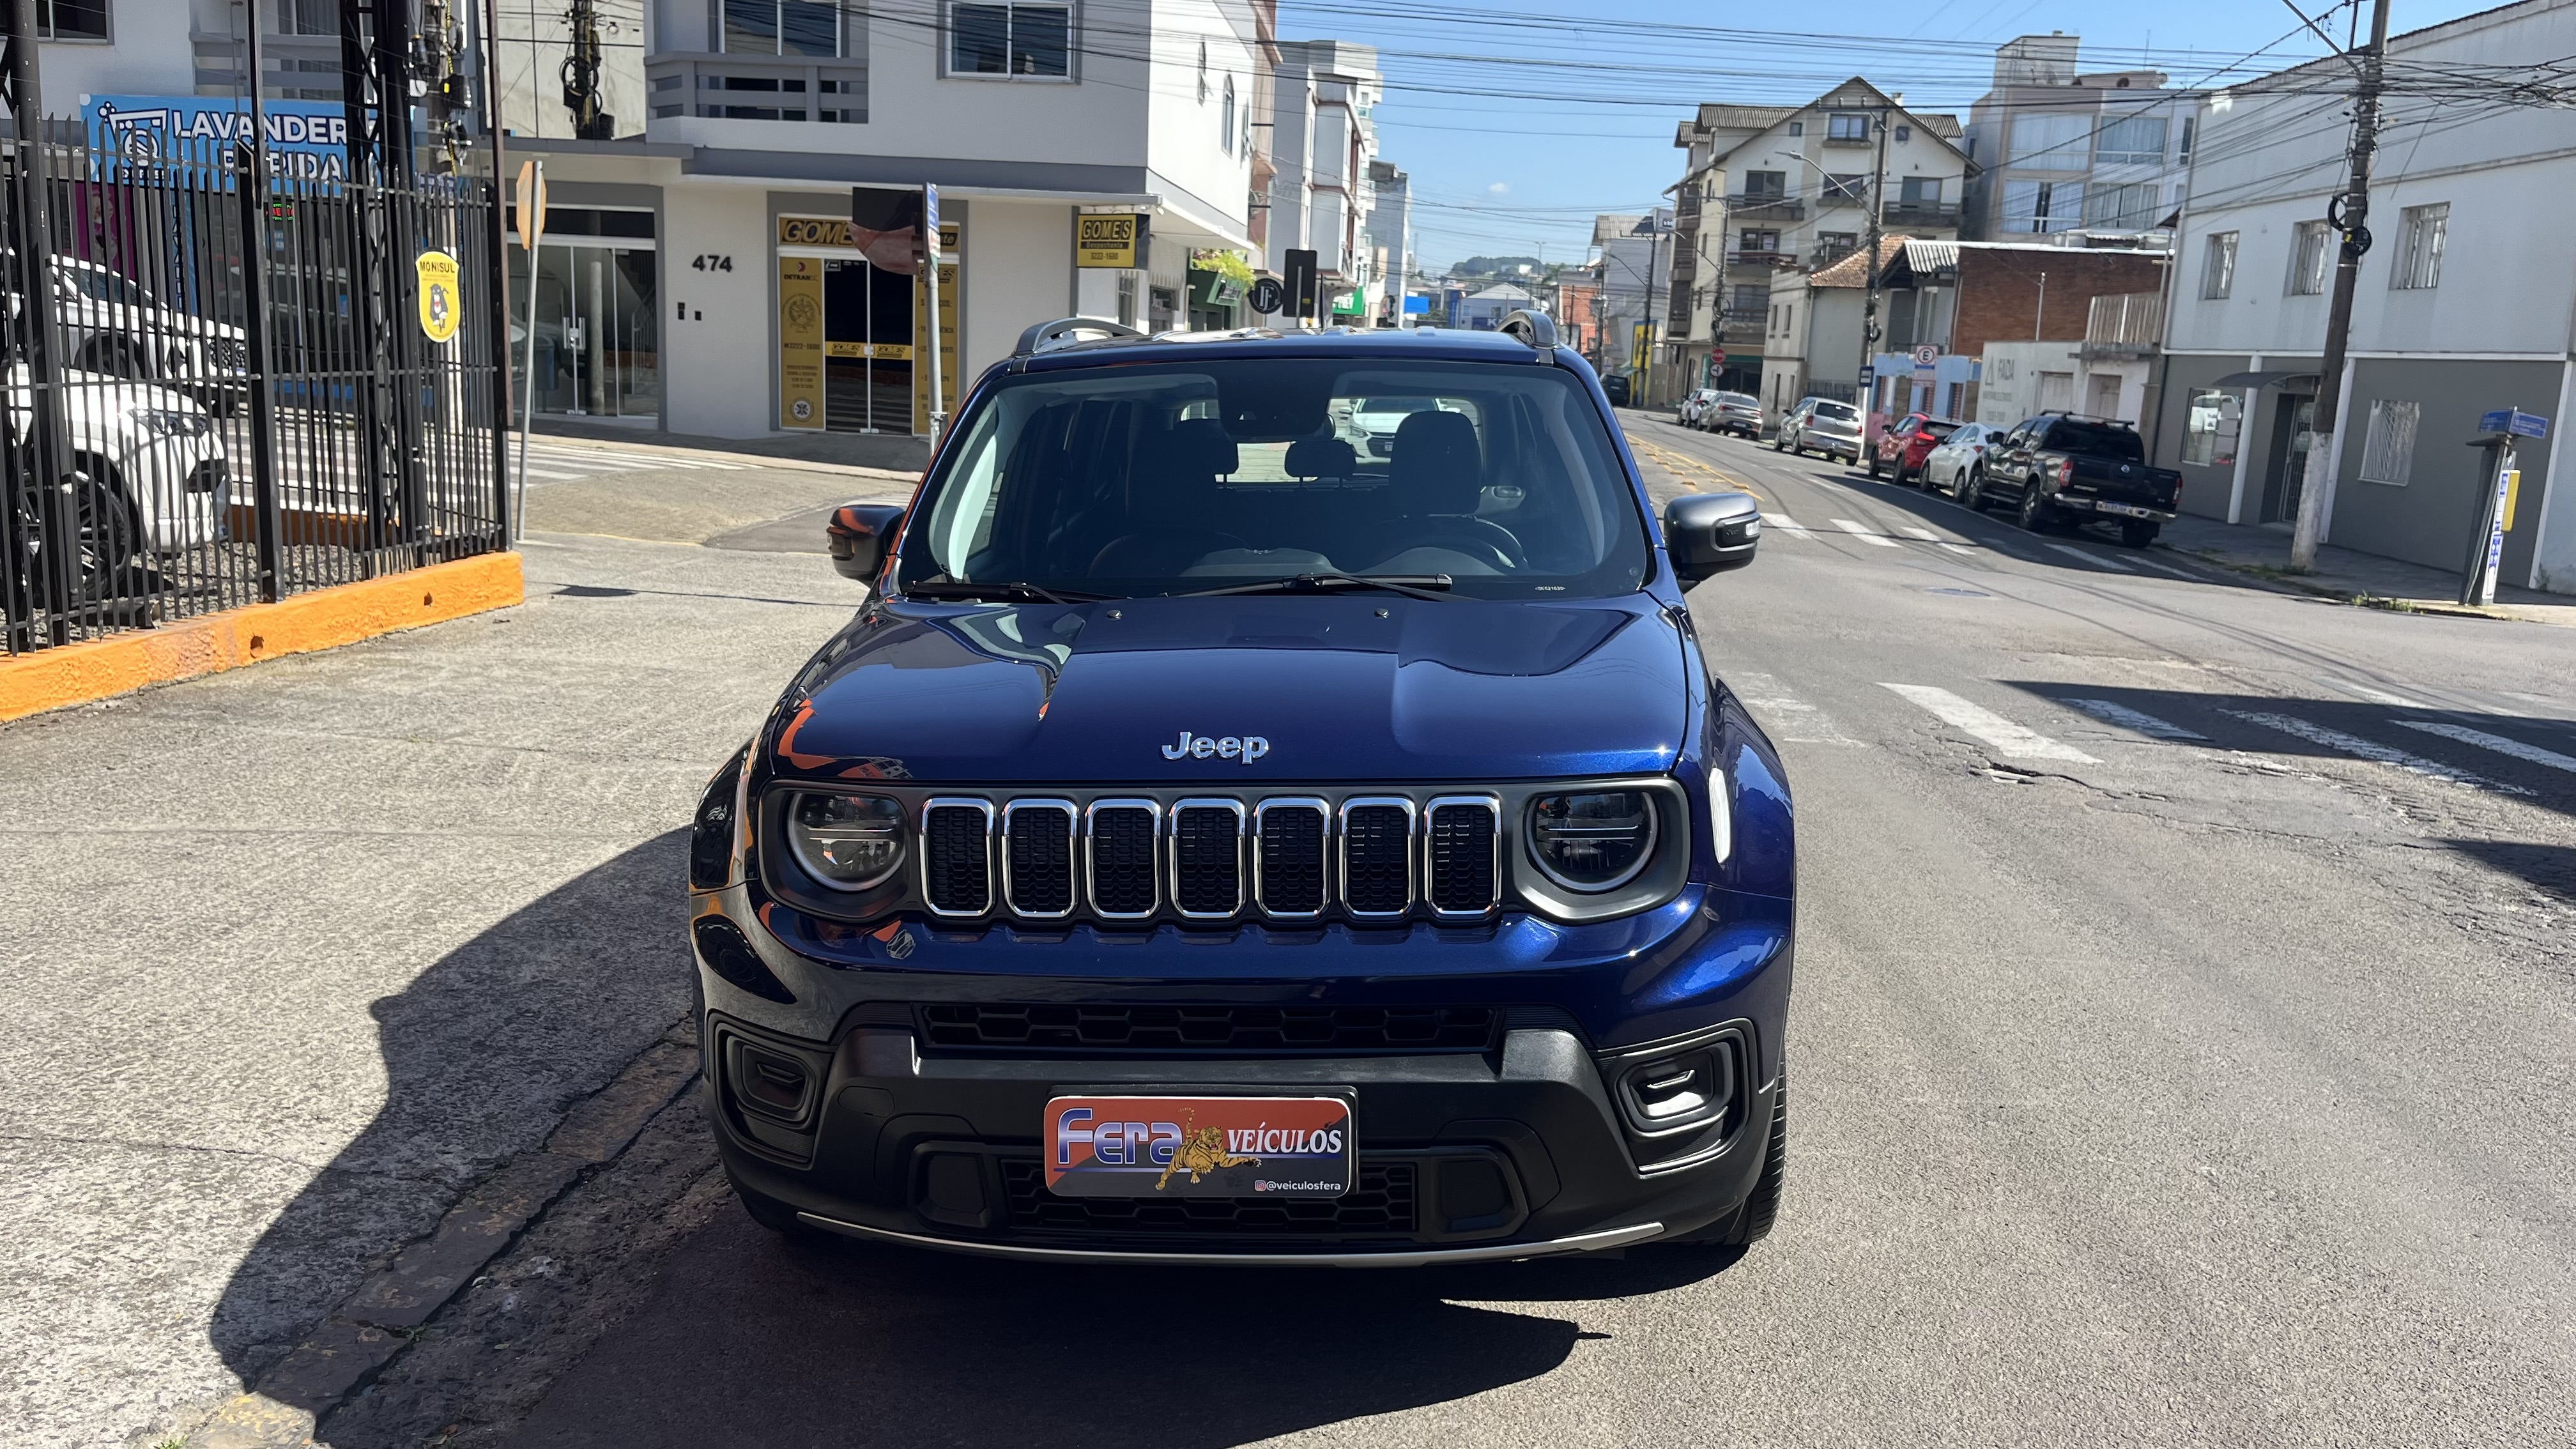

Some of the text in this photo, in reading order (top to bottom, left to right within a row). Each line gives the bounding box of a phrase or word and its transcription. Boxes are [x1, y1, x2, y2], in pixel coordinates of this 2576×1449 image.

[172, 109, 379, 146] LAVANDER
[783, 220, 854, 244] GOME
[1082, 220, 1131, 238] GOMES
[419, 261, 455, 273] MONISUL
[692, 255, 732, 272] 474
[1162, 732, 1269, 764] Jeep
[1057, 1108, 1342, 1165] Fera VEÍCULOS
[1266, 1181, 1341, 1192] @veiculosfera
